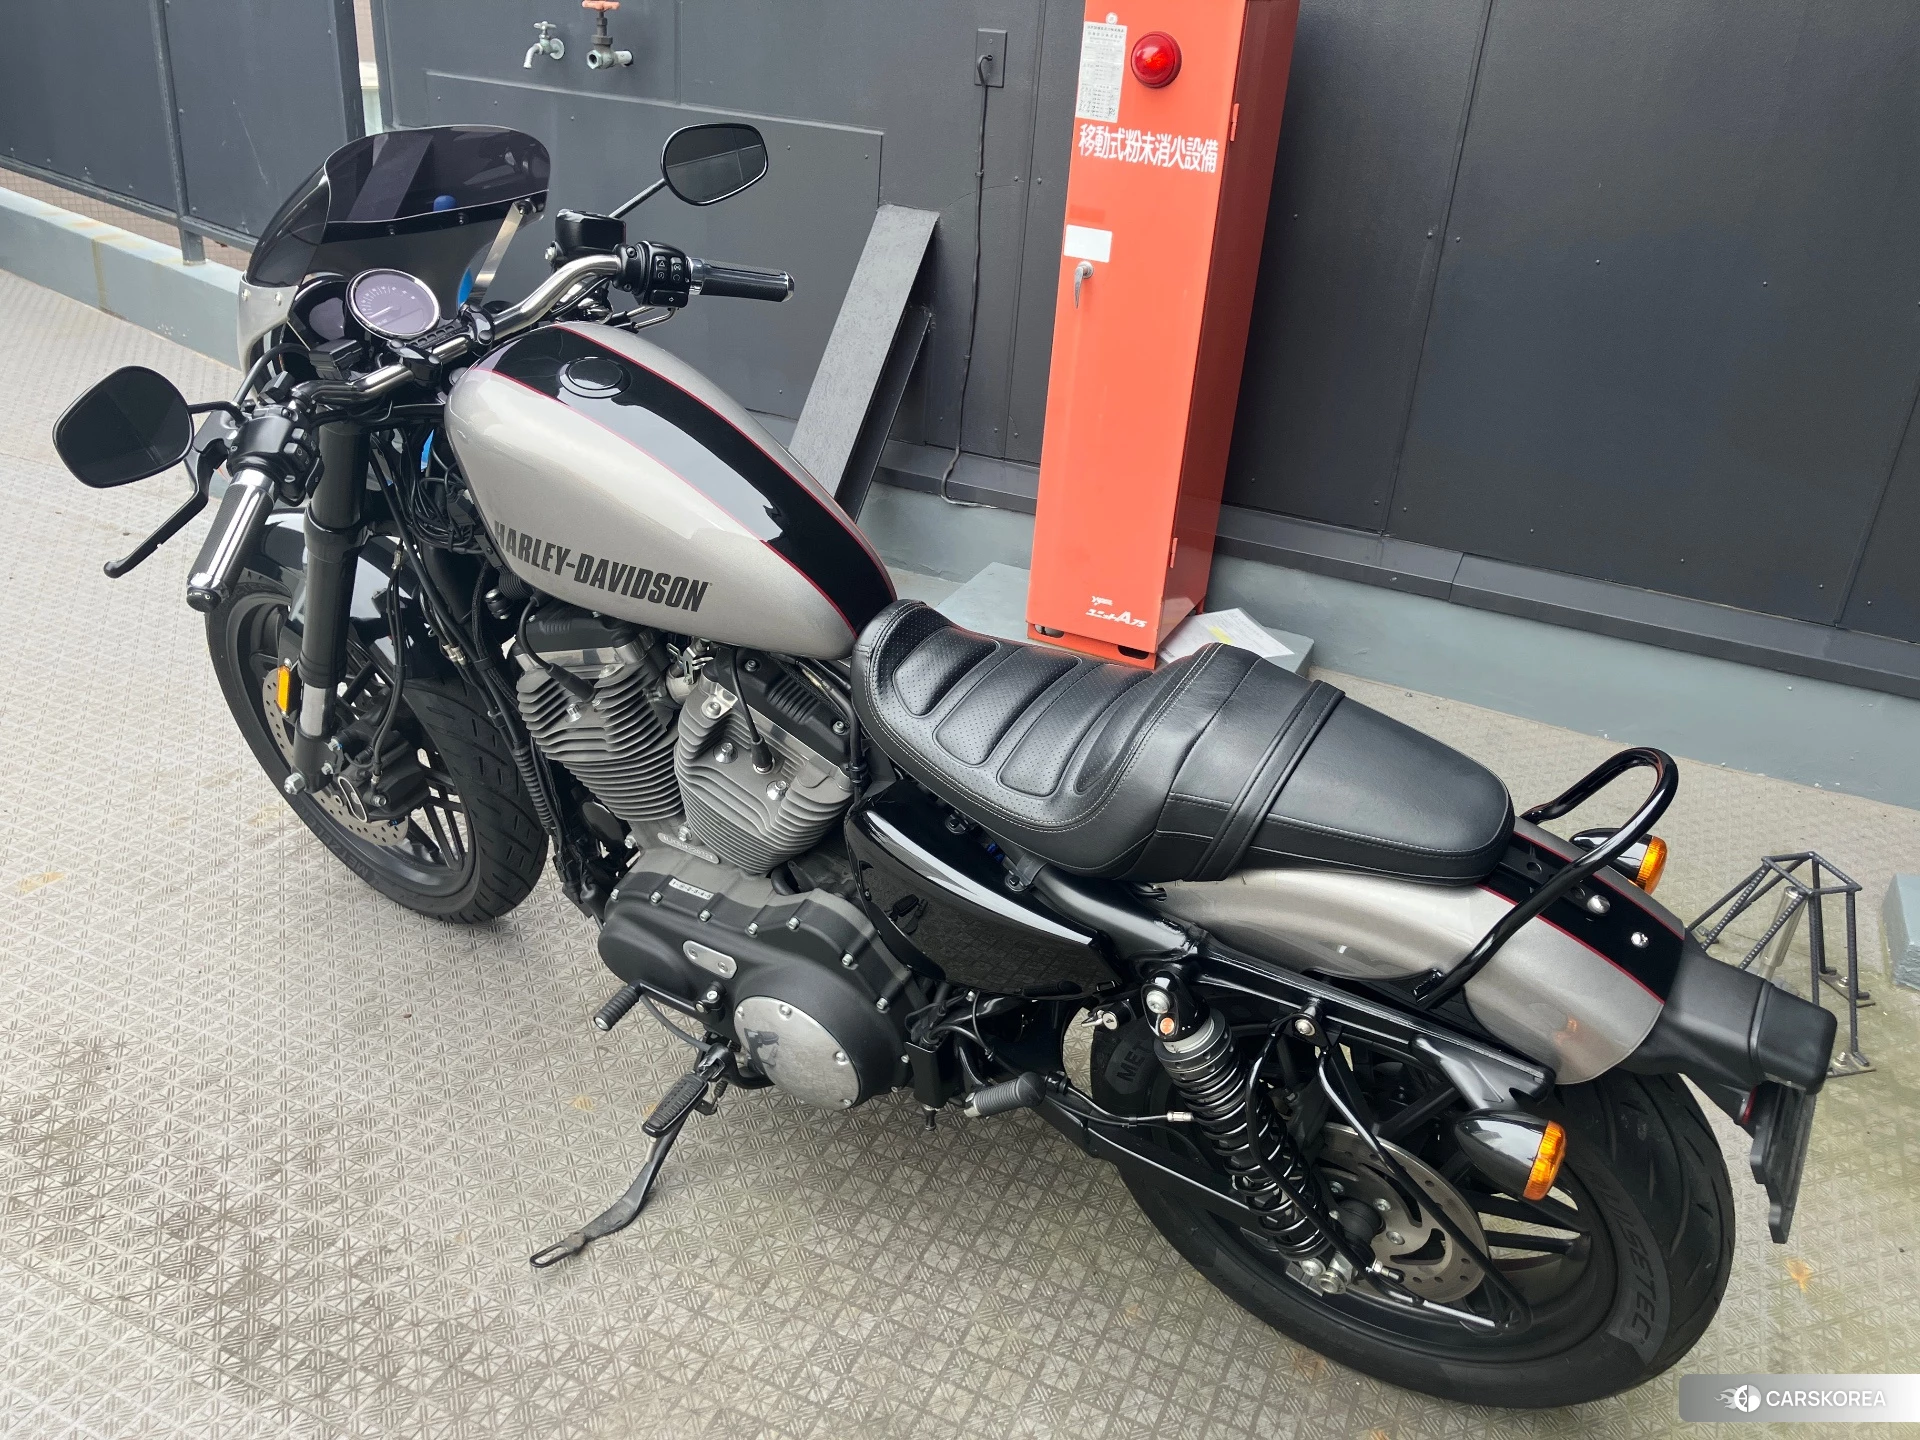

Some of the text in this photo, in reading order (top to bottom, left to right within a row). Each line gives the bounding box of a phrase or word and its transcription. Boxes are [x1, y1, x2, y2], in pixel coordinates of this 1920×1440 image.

[1079, 124, 1219, 173] 移動式粉末消火設備
[494, 520, 710, 612] HARLEY-DAVIDSON
